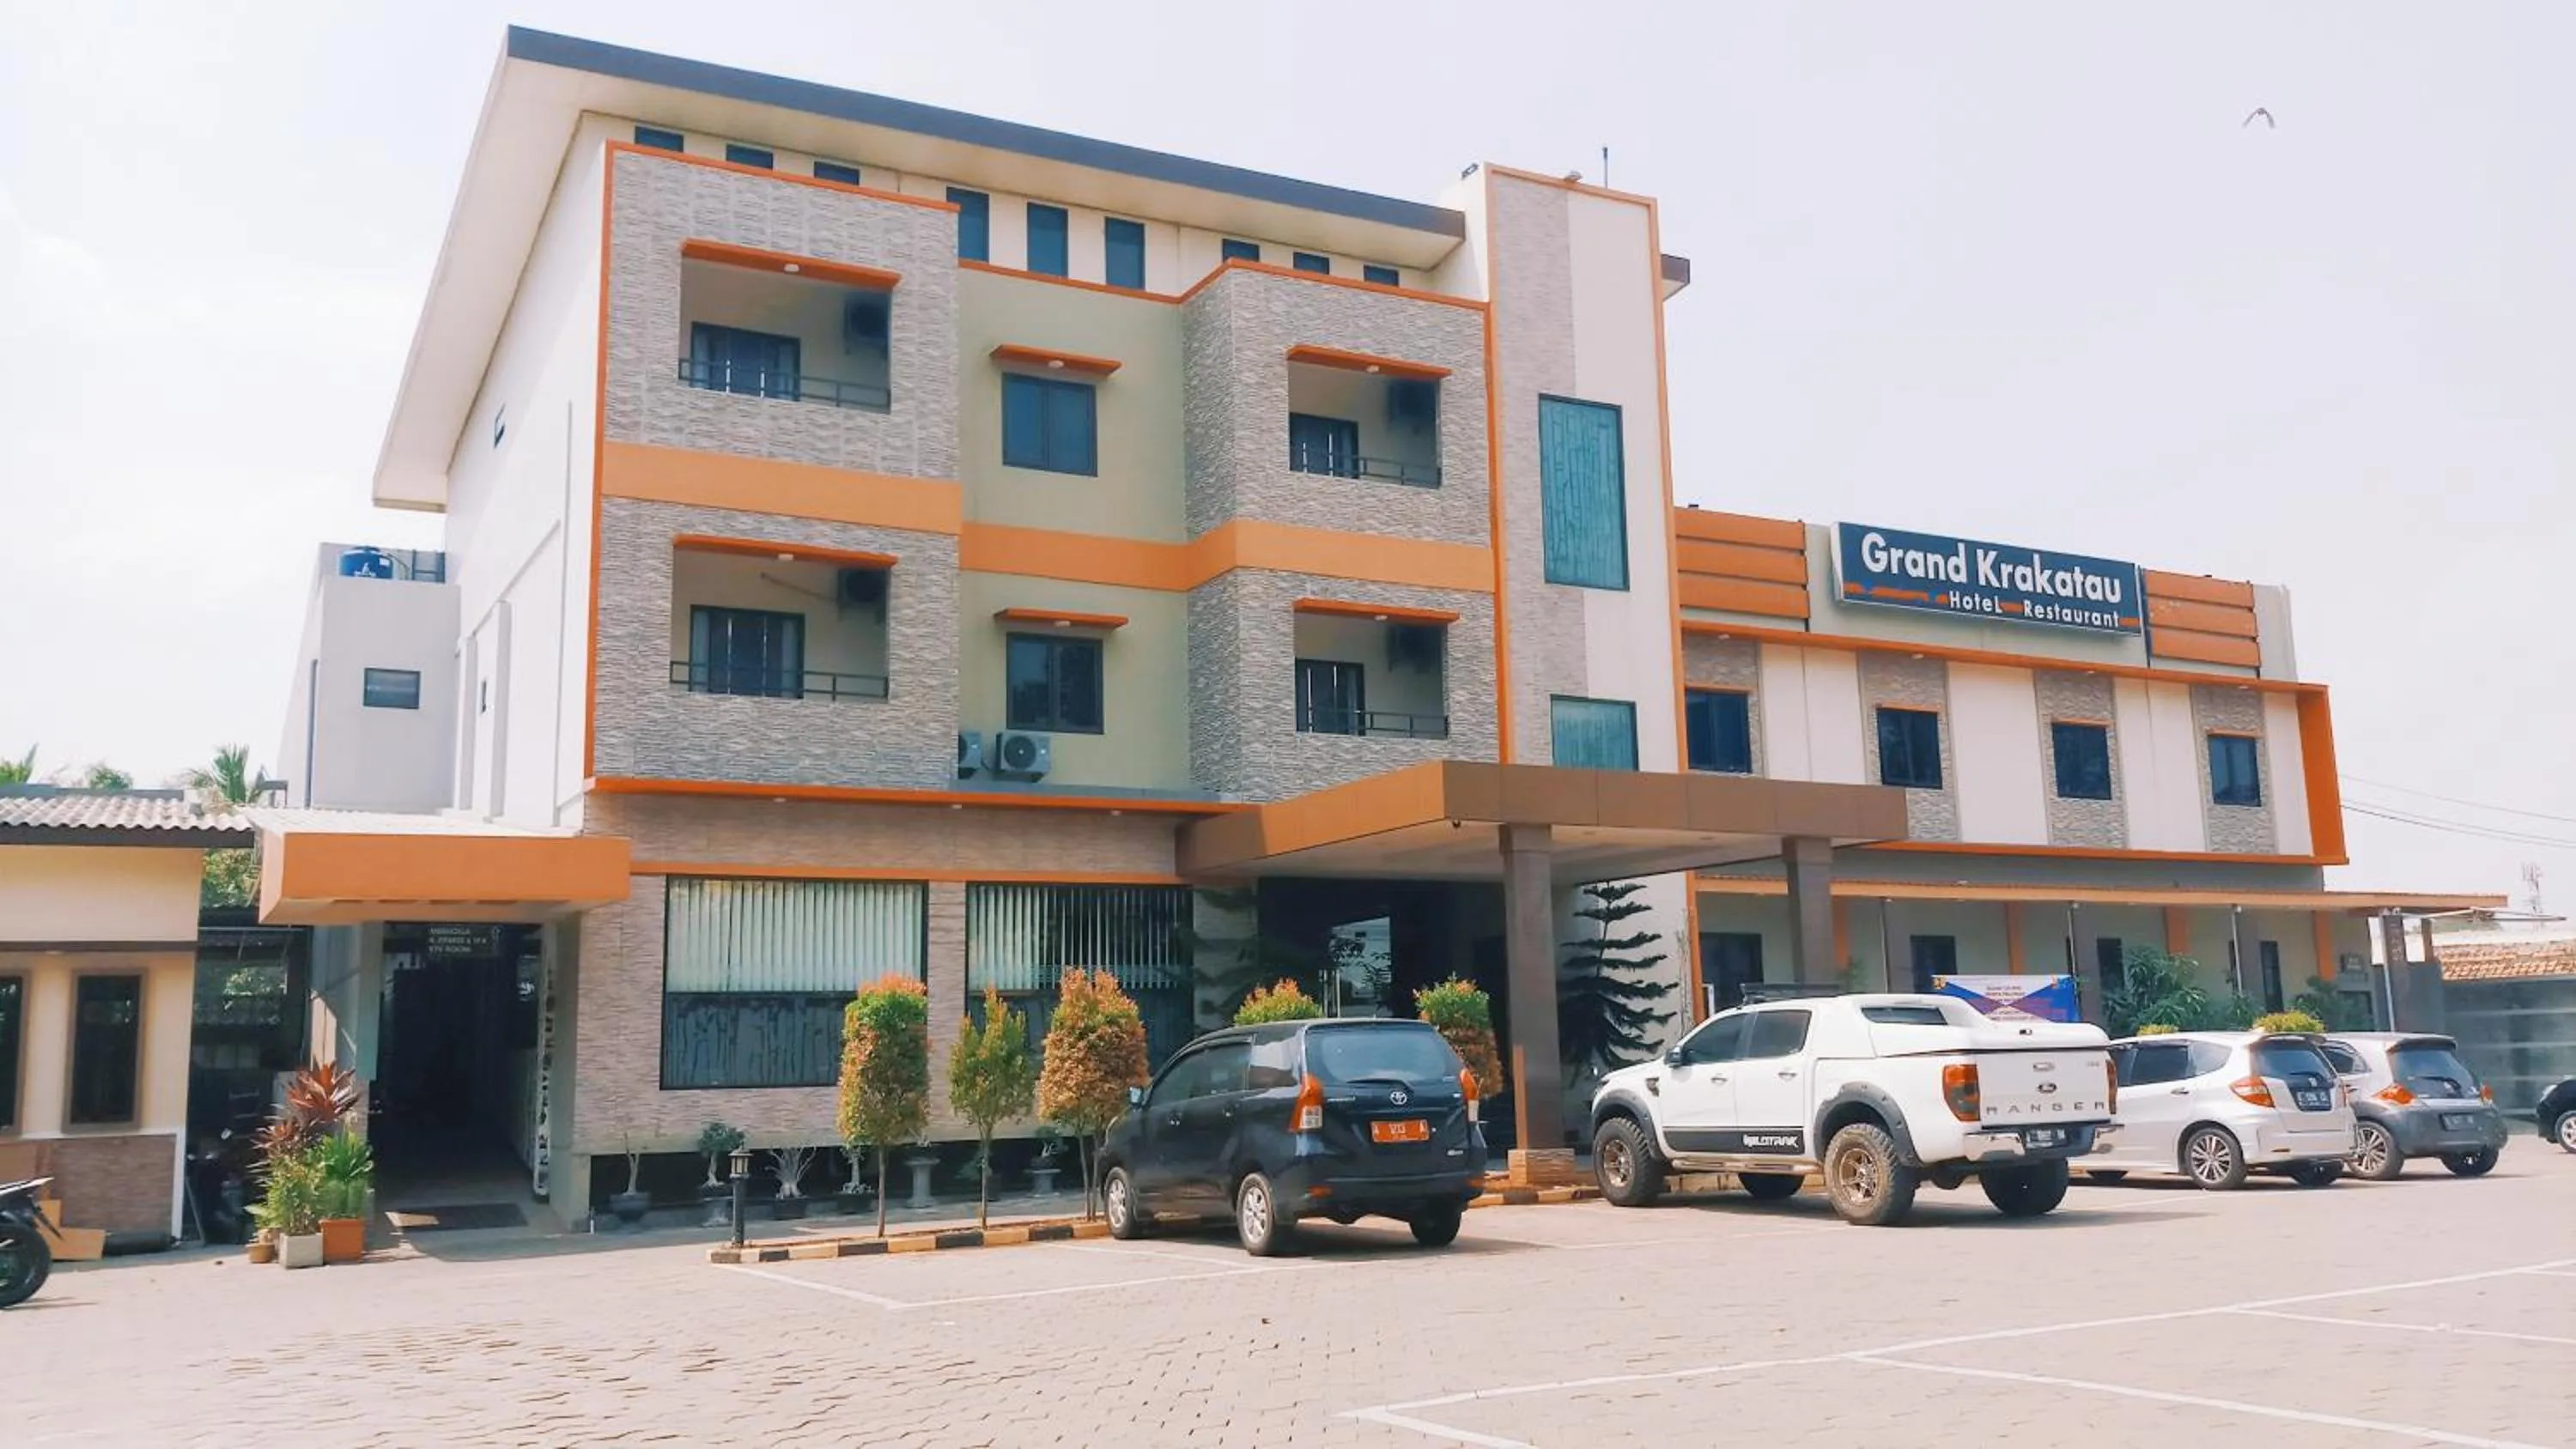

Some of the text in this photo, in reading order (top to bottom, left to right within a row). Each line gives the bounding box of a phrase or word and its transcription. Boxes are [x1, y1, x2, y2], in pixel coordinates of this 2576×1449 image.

[1862, 532, 2122, 603] Grand Krakatau
[2024, 600, 2120, 627] Restaurant
[1986, 1101, 2105, 1115] RANGER
